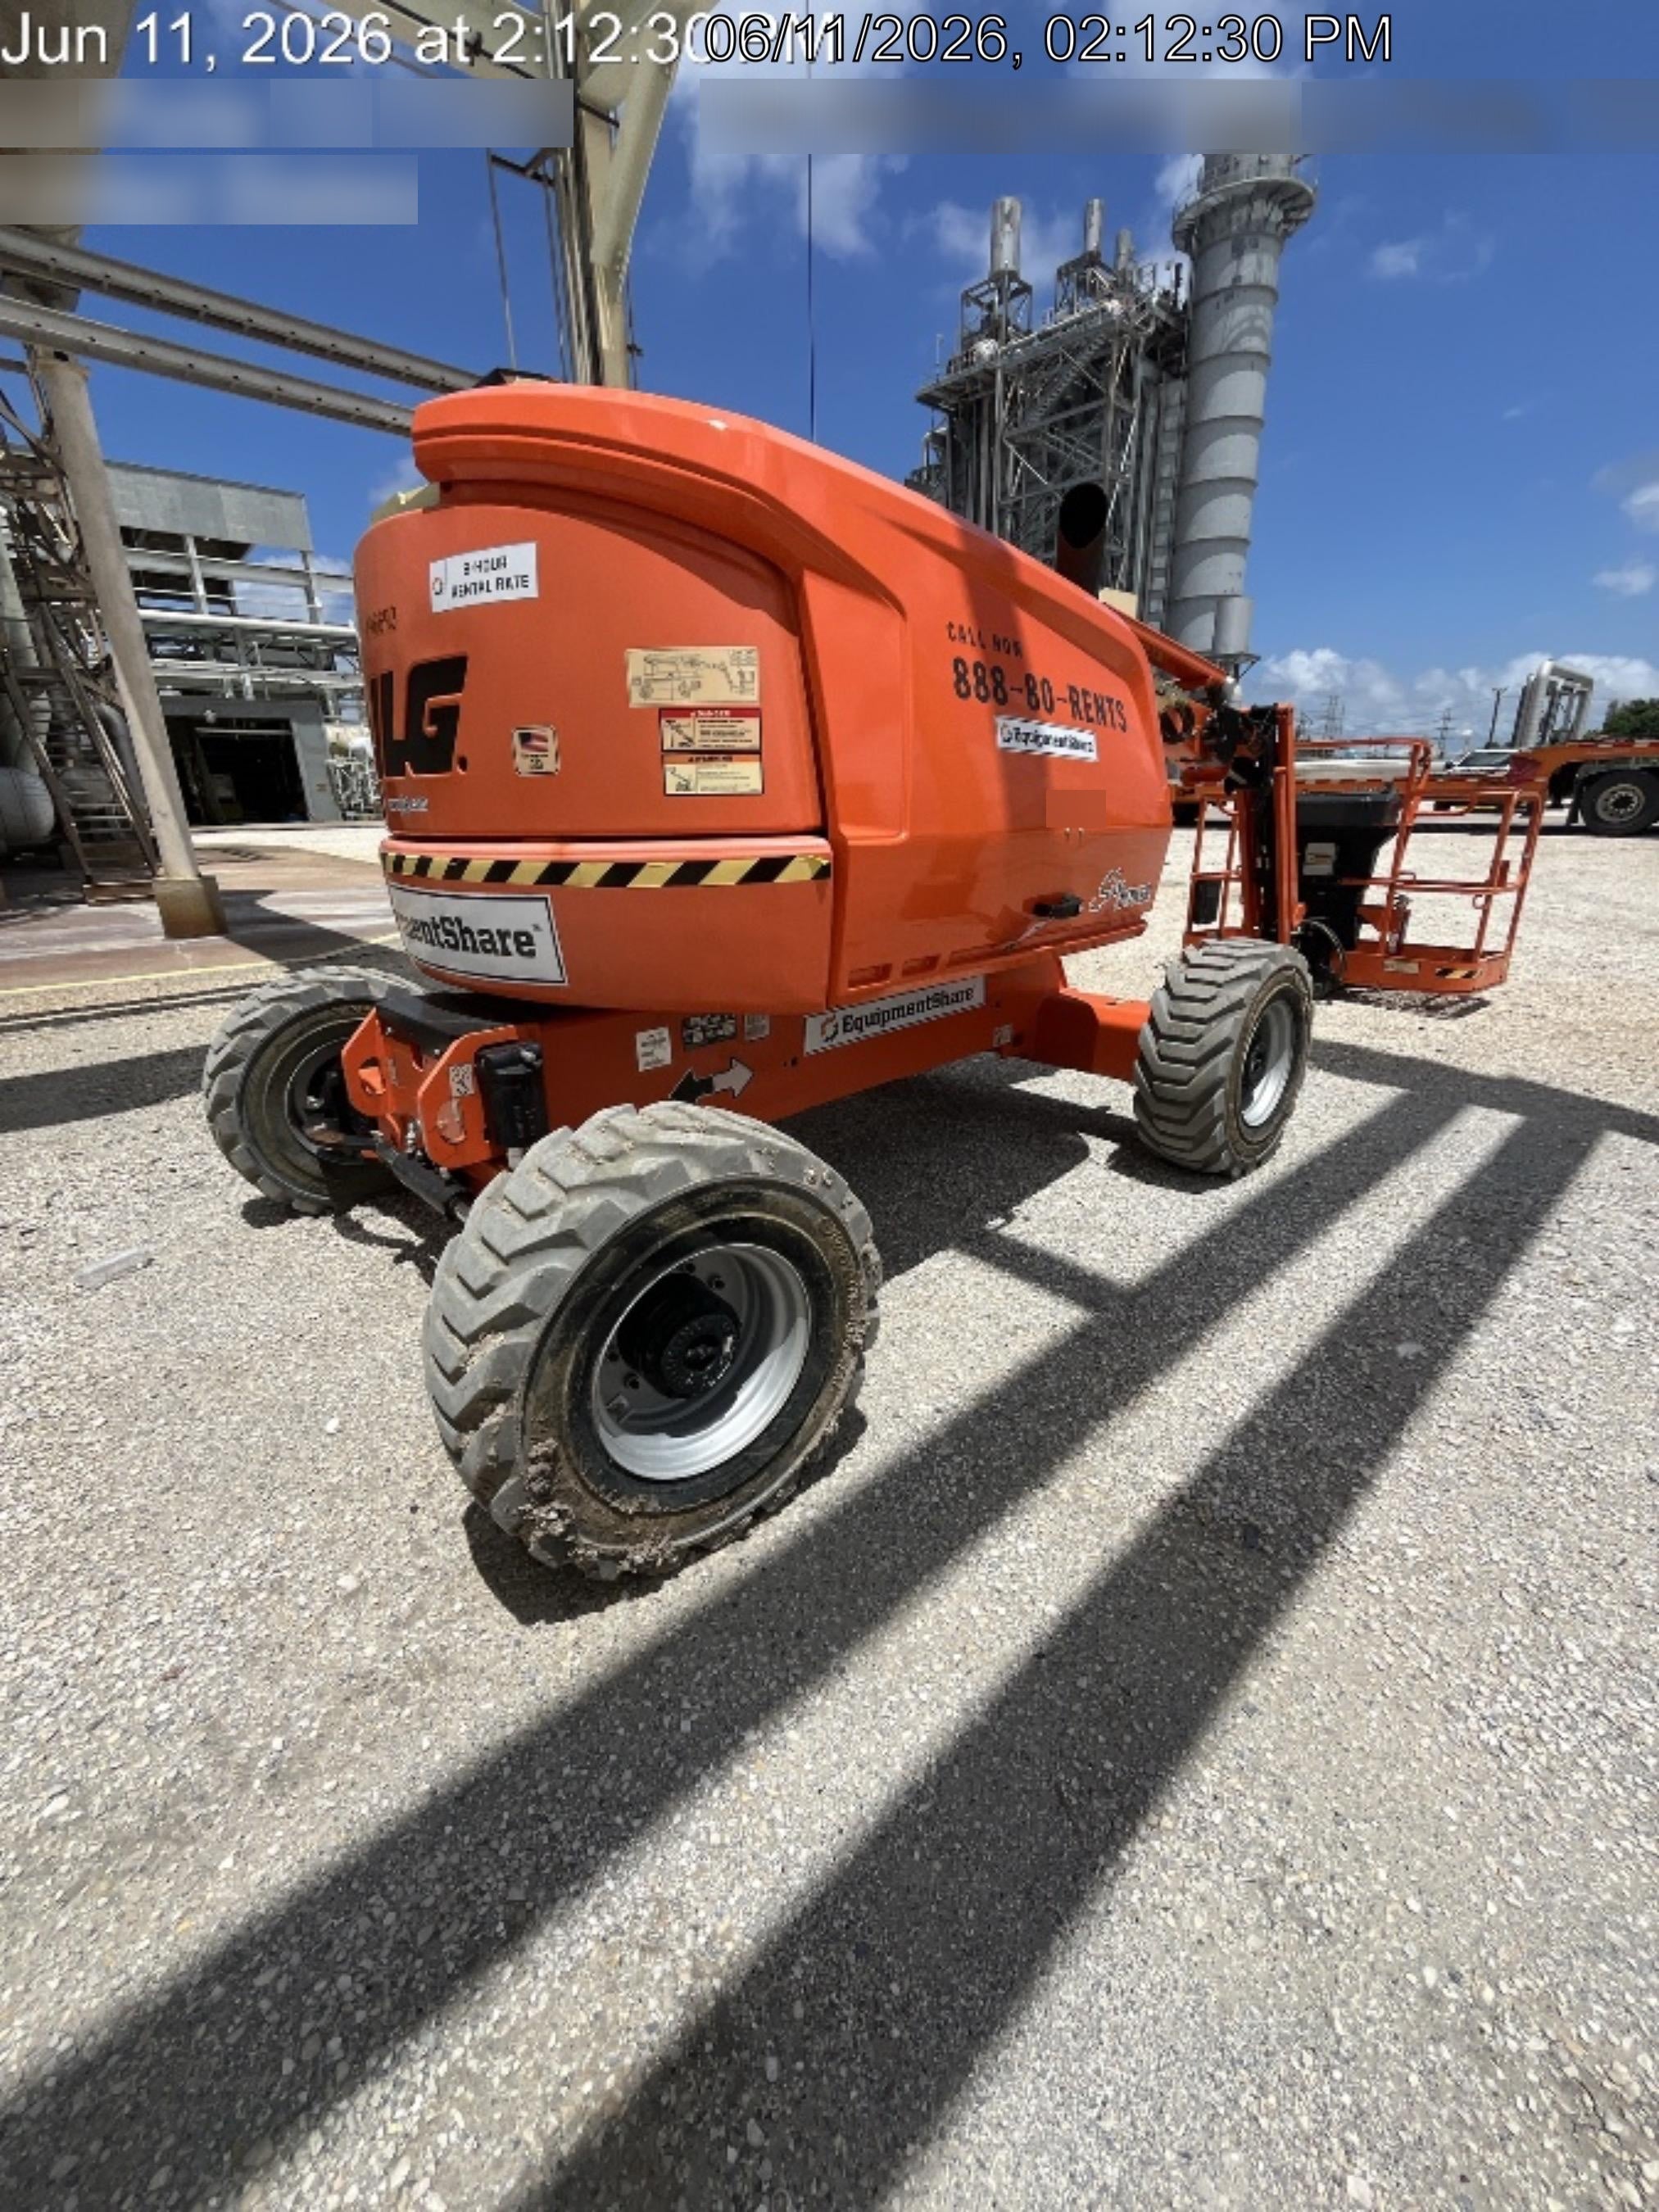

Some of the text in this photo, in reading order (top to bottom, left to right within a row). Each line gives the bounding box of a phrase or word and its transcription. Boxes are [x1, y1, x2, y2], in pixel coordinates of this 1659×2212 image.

[496, 574, 529, 591] RATE
[947, 620, 986, 650] CALL
[953, 656, 1128, 733] 888-80-RENTS
[842, 986, 975, 1036] EquipmentShare
